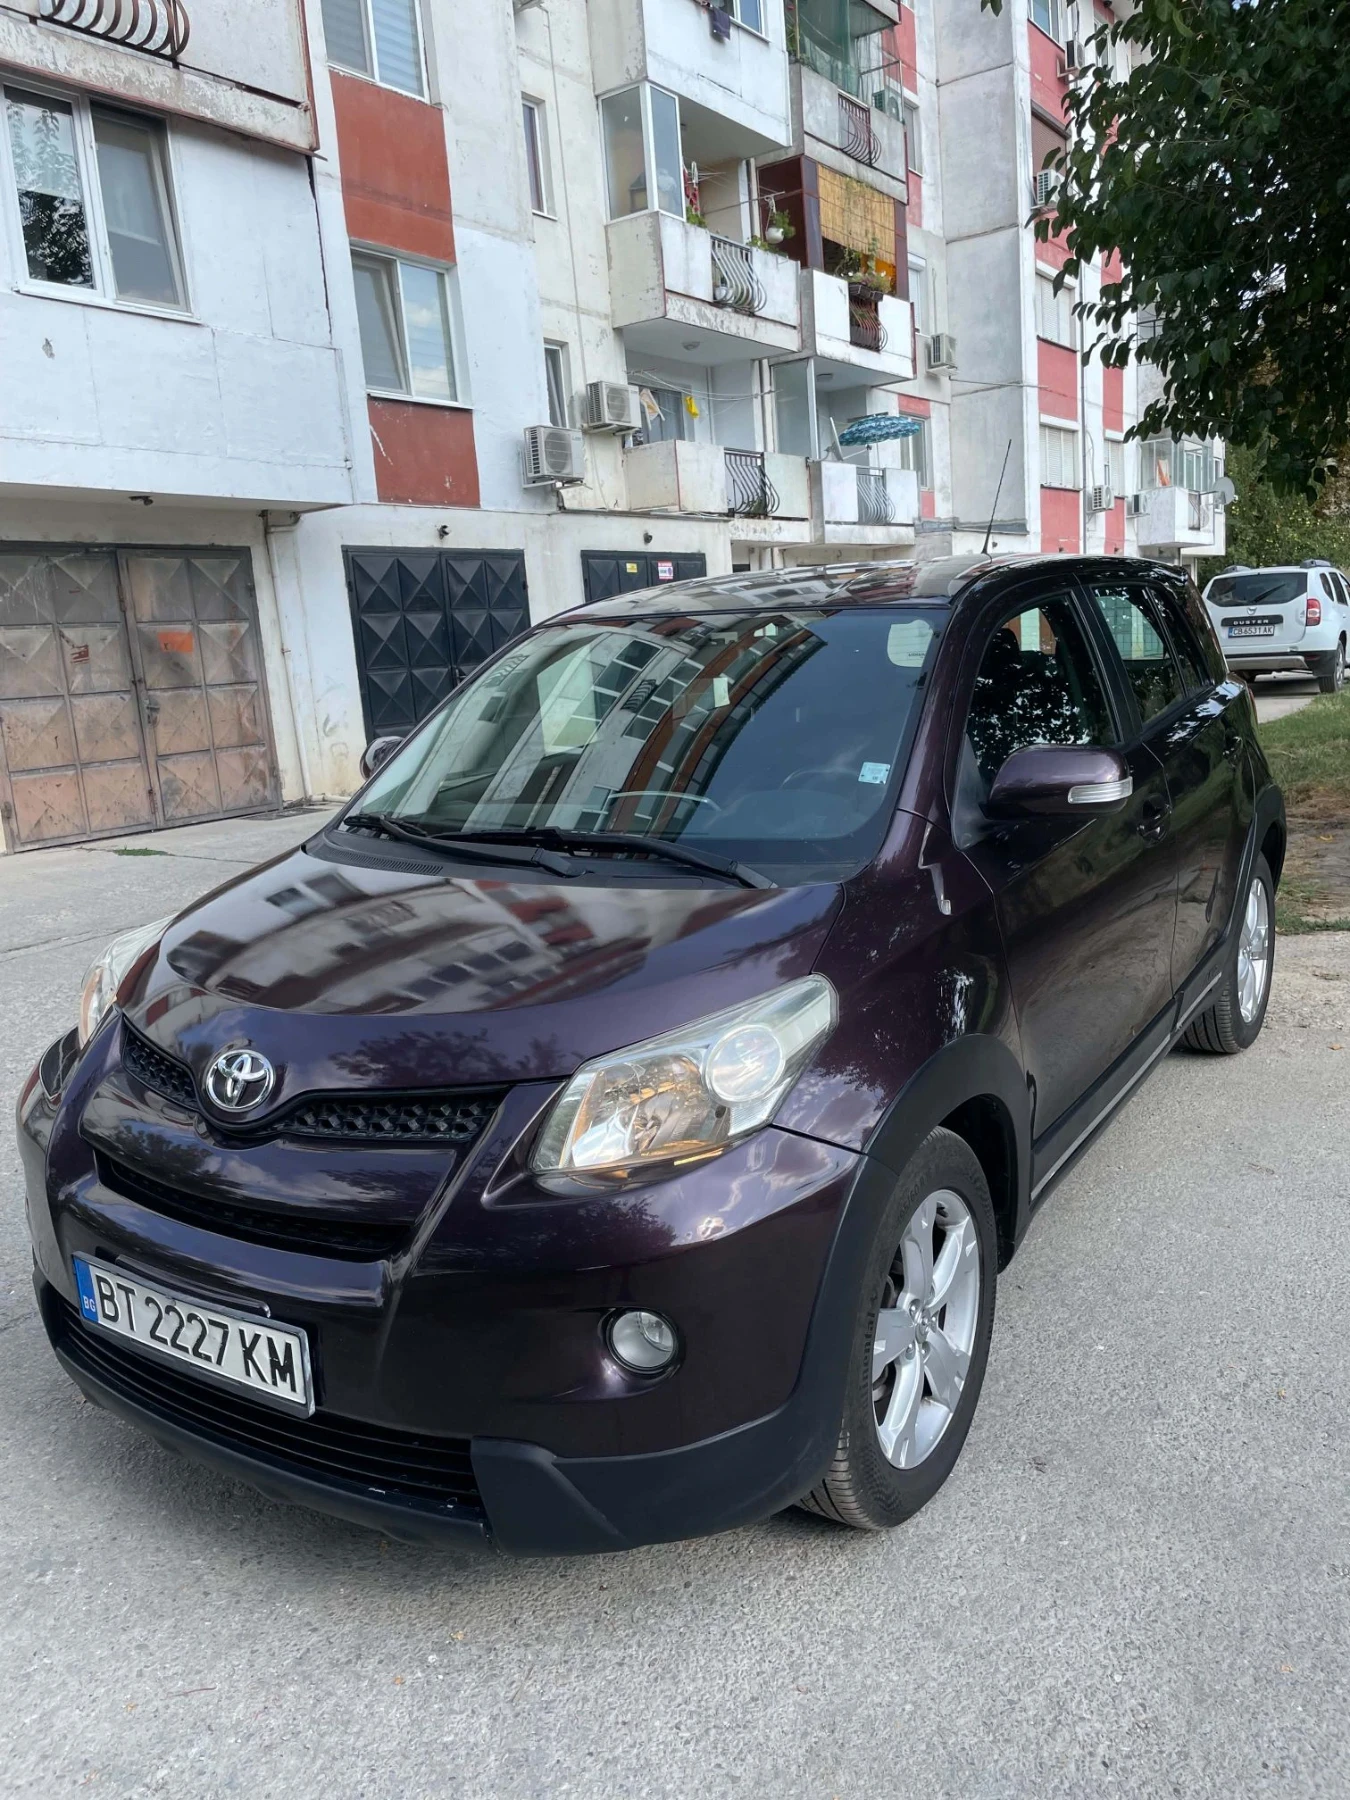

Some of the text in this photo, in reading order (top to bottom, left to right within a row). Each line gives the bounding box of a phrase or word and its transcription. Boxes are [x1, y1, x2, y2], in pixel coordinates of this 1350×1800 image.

[1262, 626, 1273, 634] AK
[83, 1295, 96, 1312] BG
[95, 1274, 298, 1394] BT 2227 KM
